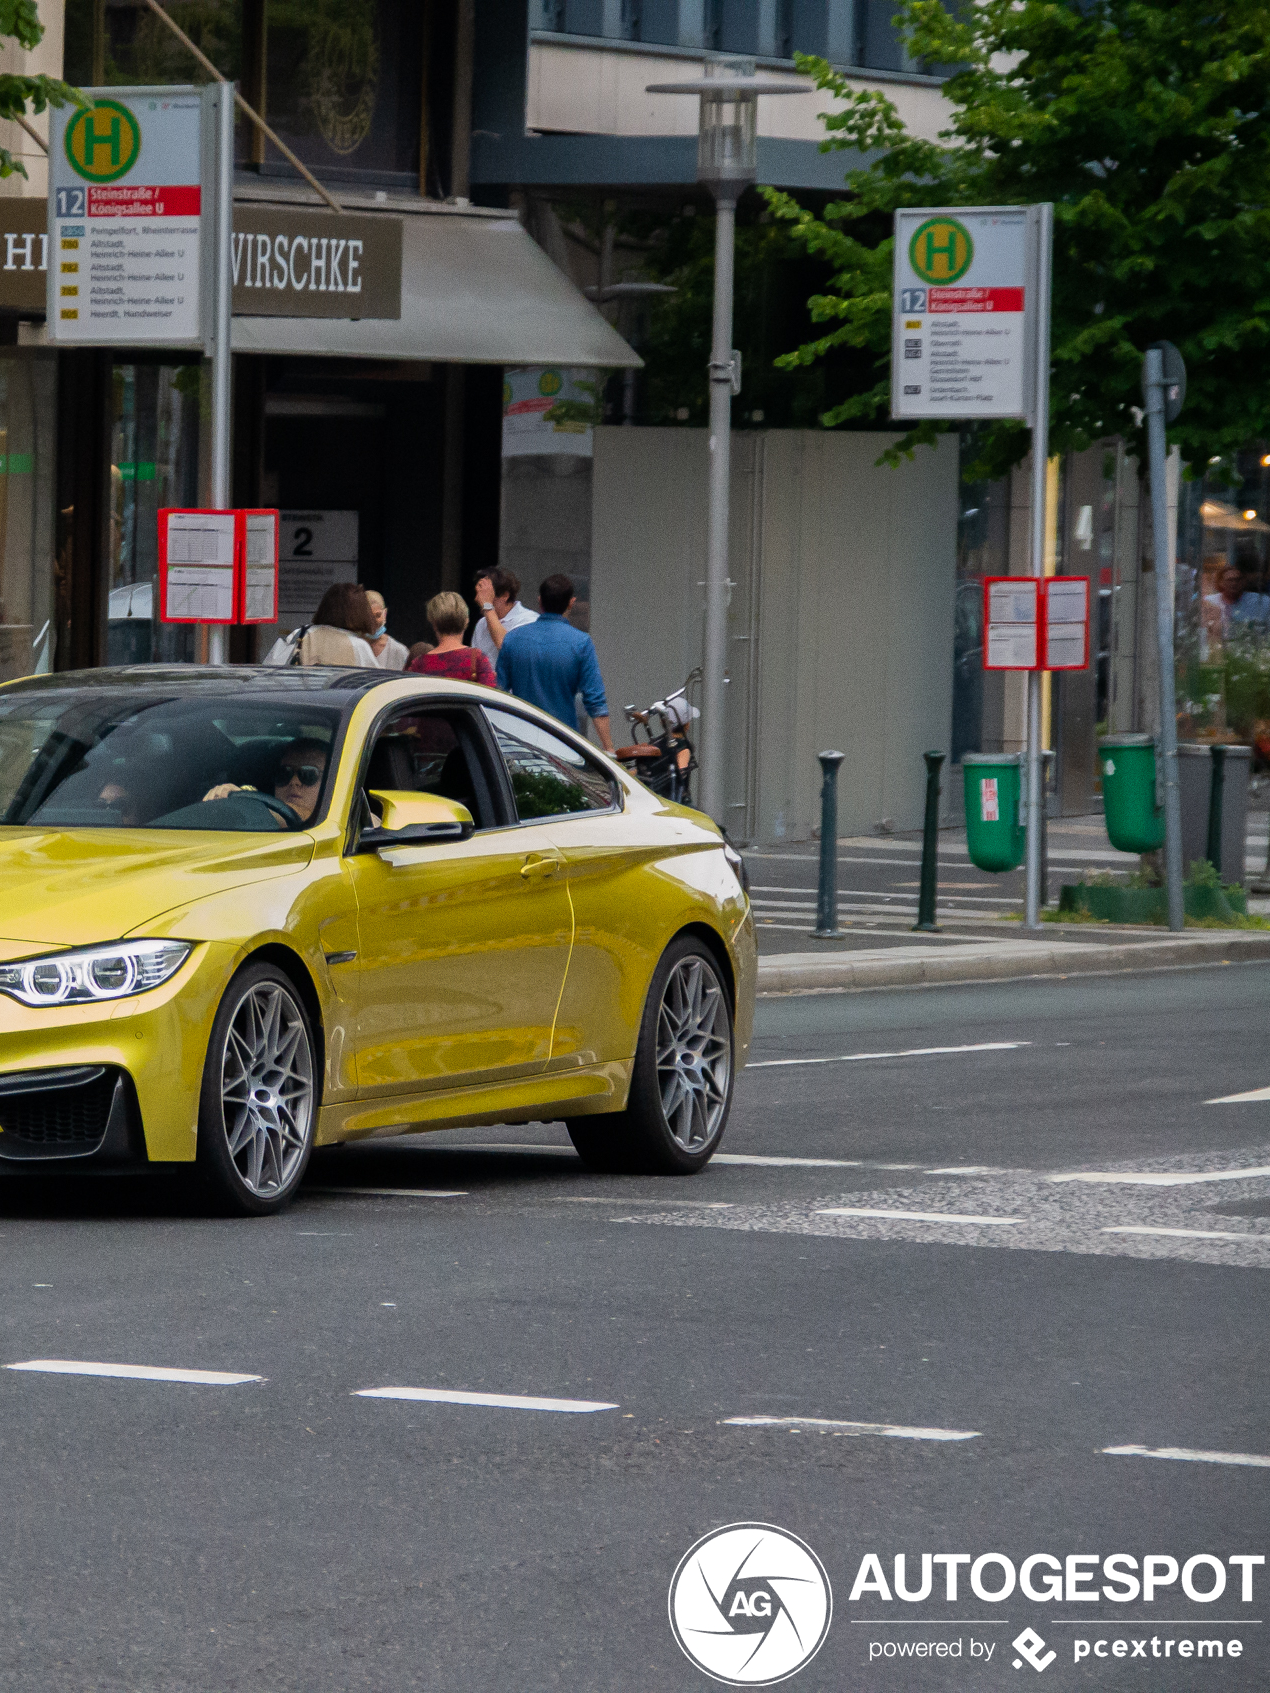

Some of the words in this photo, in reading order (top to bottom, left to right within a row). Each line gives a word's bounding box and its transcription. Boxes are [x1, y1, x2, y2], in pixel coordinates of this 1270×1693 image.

[84, 117, 121, 166] H
[58, 190, 84, 214] 12
[90, 187, 152, 200] Steinstraße
[90, 202, 153, 217] Königsallee
[155, 202, 164, 214] U
[925, 231, 956, 271] H
[902, 291, 925, 311] 12
[293, 527, 313, 556] 2
